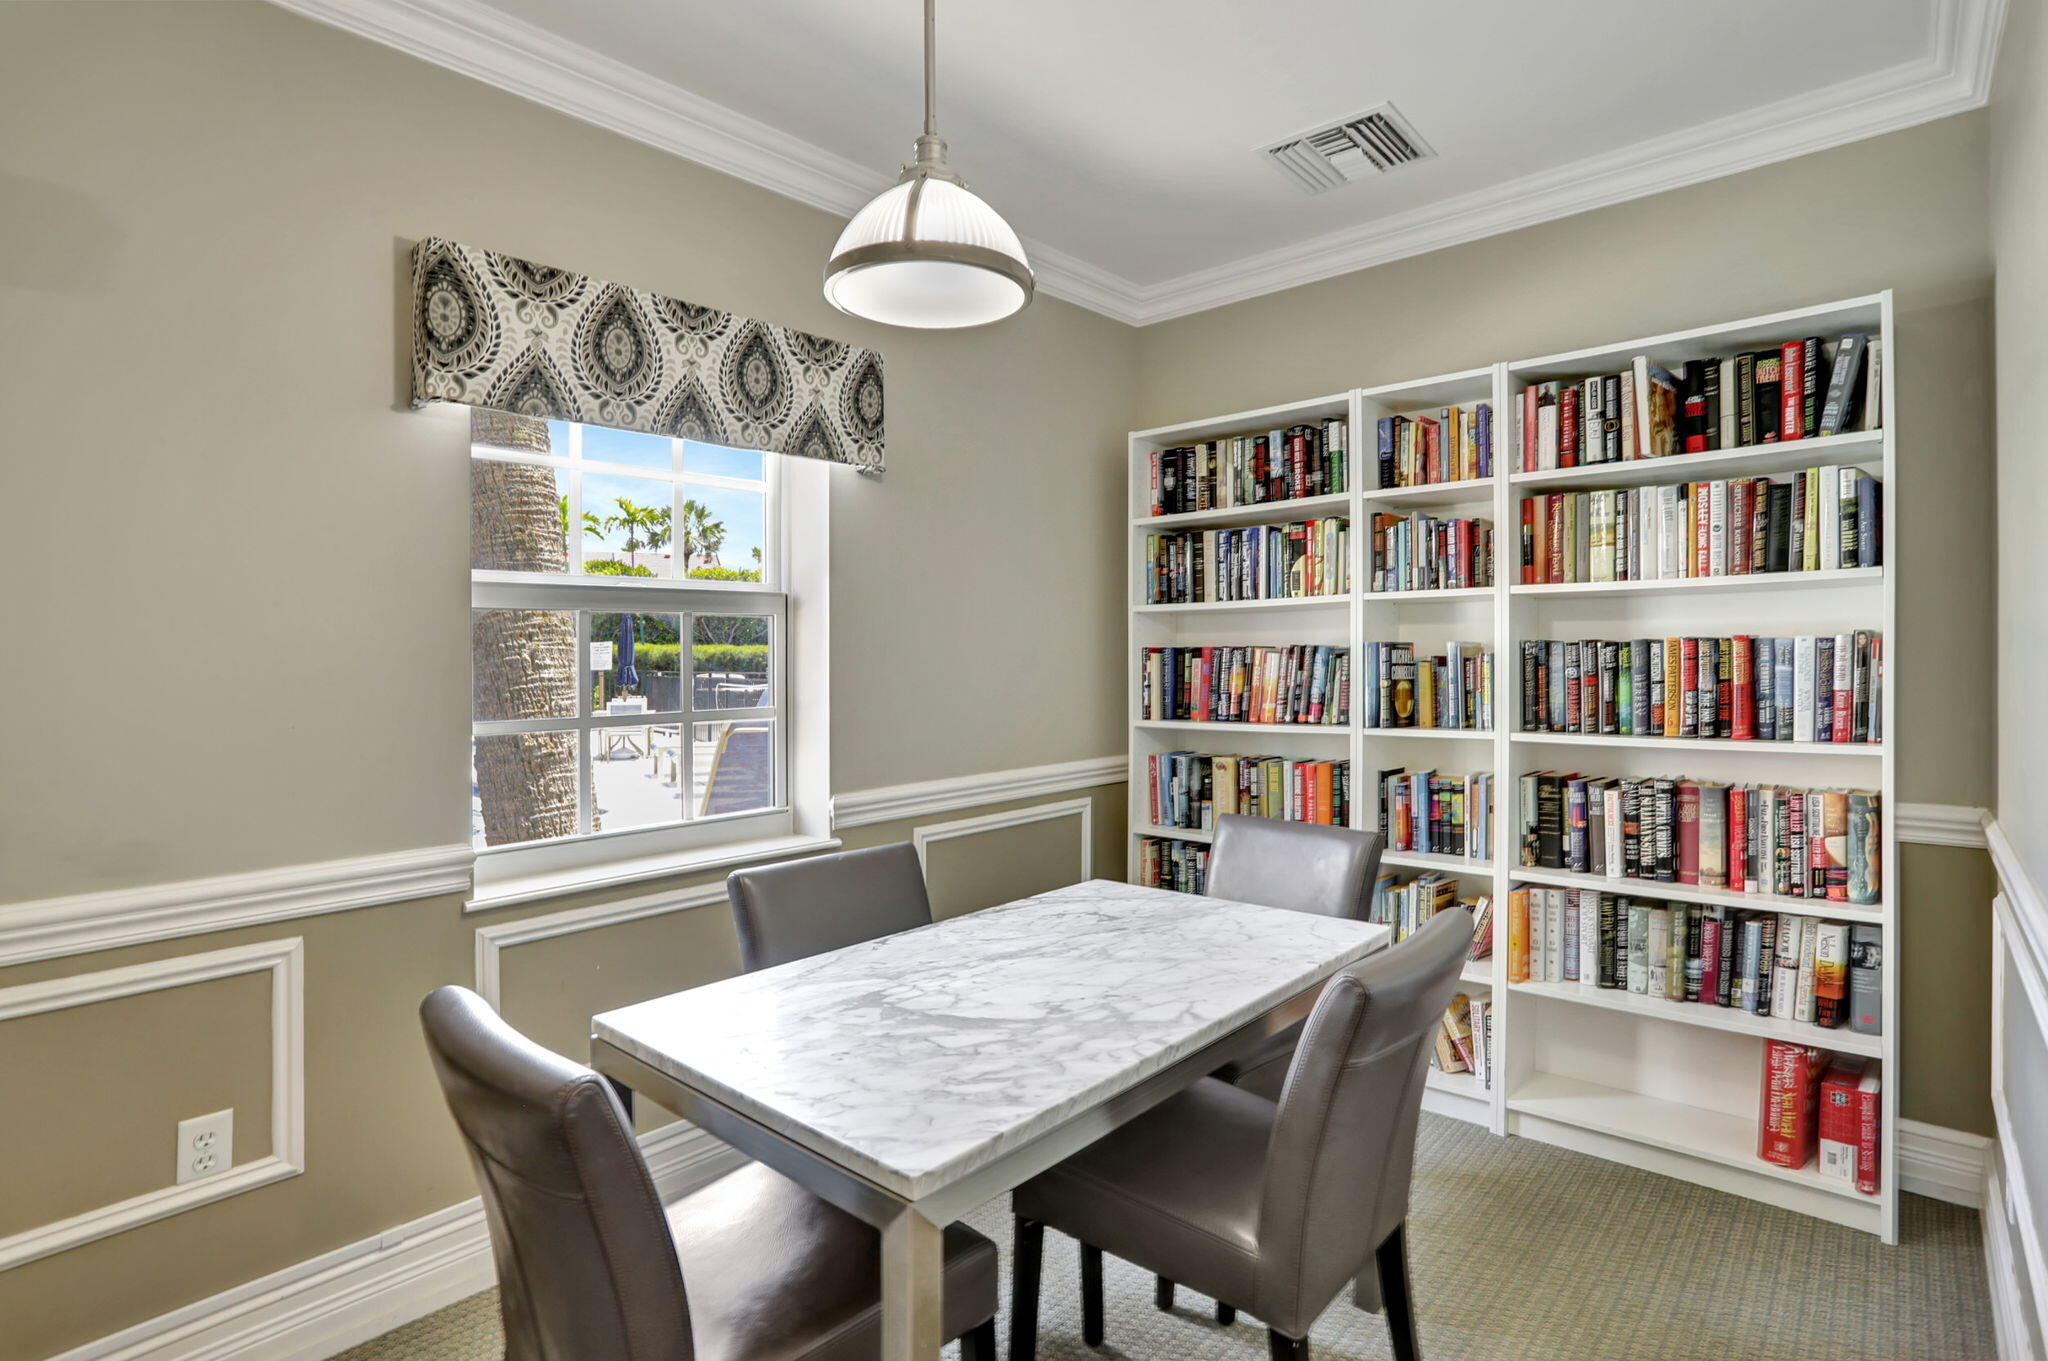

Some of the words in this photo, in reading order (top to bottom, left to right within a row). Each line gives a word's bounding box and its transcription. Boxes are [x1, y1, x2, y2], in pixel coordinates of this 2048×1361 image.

[1785, 347, 1796, 362] John
[1805, 338, 1816, 370] MICHAEL
[1785, 363, 1796, 395] Lescroart
[1804, 371, 1815, 395] LEWIS
[1787, 396, 1795, 406] THE
[1785, 407, 1795, 434] HUNTER
[1698, 487, 1708, 525] MOSLEY
[1734, 485, 1742, 527] SEPULCHRE
[1698, 529, 1708, 548] LONG
[1698, 550, 1708, 568] FALL
[1668, 640, 1678, 665] JAMES
[1700, 642, 1710, 656] JAMES
[1719, 641, 1729, 654] JAMES
[1759, 644, 1769, 661] JOHN
[1700, 657, 1710, 683] PATTERSON
[1719, 655, 1729, 679] PATTERSON
[1759, 662, 1769, 694] CONNOLLY
[1634, 673, 1643, 715] HERESY
[1652, 683, 1662, 704] DOUBLE
[1668, 665, 1678, 711] PATTERSON
[1700, 692, 1710, 707] THE
[1567, 679, 1579, 724] APPALOOSA
[1719, 705, 1730, 720] FIRE
[1700, 708, 1710, 722] INN
[1655, 793, 1670, 825] CAPITAL
[1790, 795, 1802, 811] LADY
[1812, 796, 1820, 808] LISA
[1790, 812, 1802, 832] KILLER
[1812, 808, 1820, 836] SCOTTOLINE
[1655, 826, 1670, 858] CRIMES
[1790, 834, 1801, 848] LISA
[1640, 842, 1655, 866] STING
[1790, 849, 1801, 884] SCOTTOLINE
[1600, 901, 1615, 916] AMY
[1600, 917, 1615, 931] TAN
[1761, 920, 1773, 947] STUART
[1780, 918, 1791, 954] SHADOW
[1806, 923, 1816, 936] Bob
[1800, 936, 1814, 968] Woodward
[1819, 933, 1836, 958] Nelson
[1760, 948, 1773, 975] WOODS
[1819, 960, 1834, 986] DeMille
[1800, 970, 1810, 982] The
[1778, 982, 1786, 1013] WOODWARD
[1798, 983, 1809, 1006] Agenda
[1818, 997, 1834, 1008] Wild
[1471, 1004, 1481, 1032] SOLITARY
[1819, 1008, 1833, 1017] Fire
[1770, 1045, 1784, 1069] Large
[1783, 1045, 1804, 1089] Webster's
[1770, 1070, 1784, 1090] Print
[1769, 1091, 1784, 1132] Dictionary
[1781, 1092, 1798, 1110] New
[1859, 1094, 1875, 1121] Complete
[1779, 1111, 1797, 1139] World
[1861, 1123, 1875, 1140] Guide
[1858, 1151, 1874, 1172] Sewing
